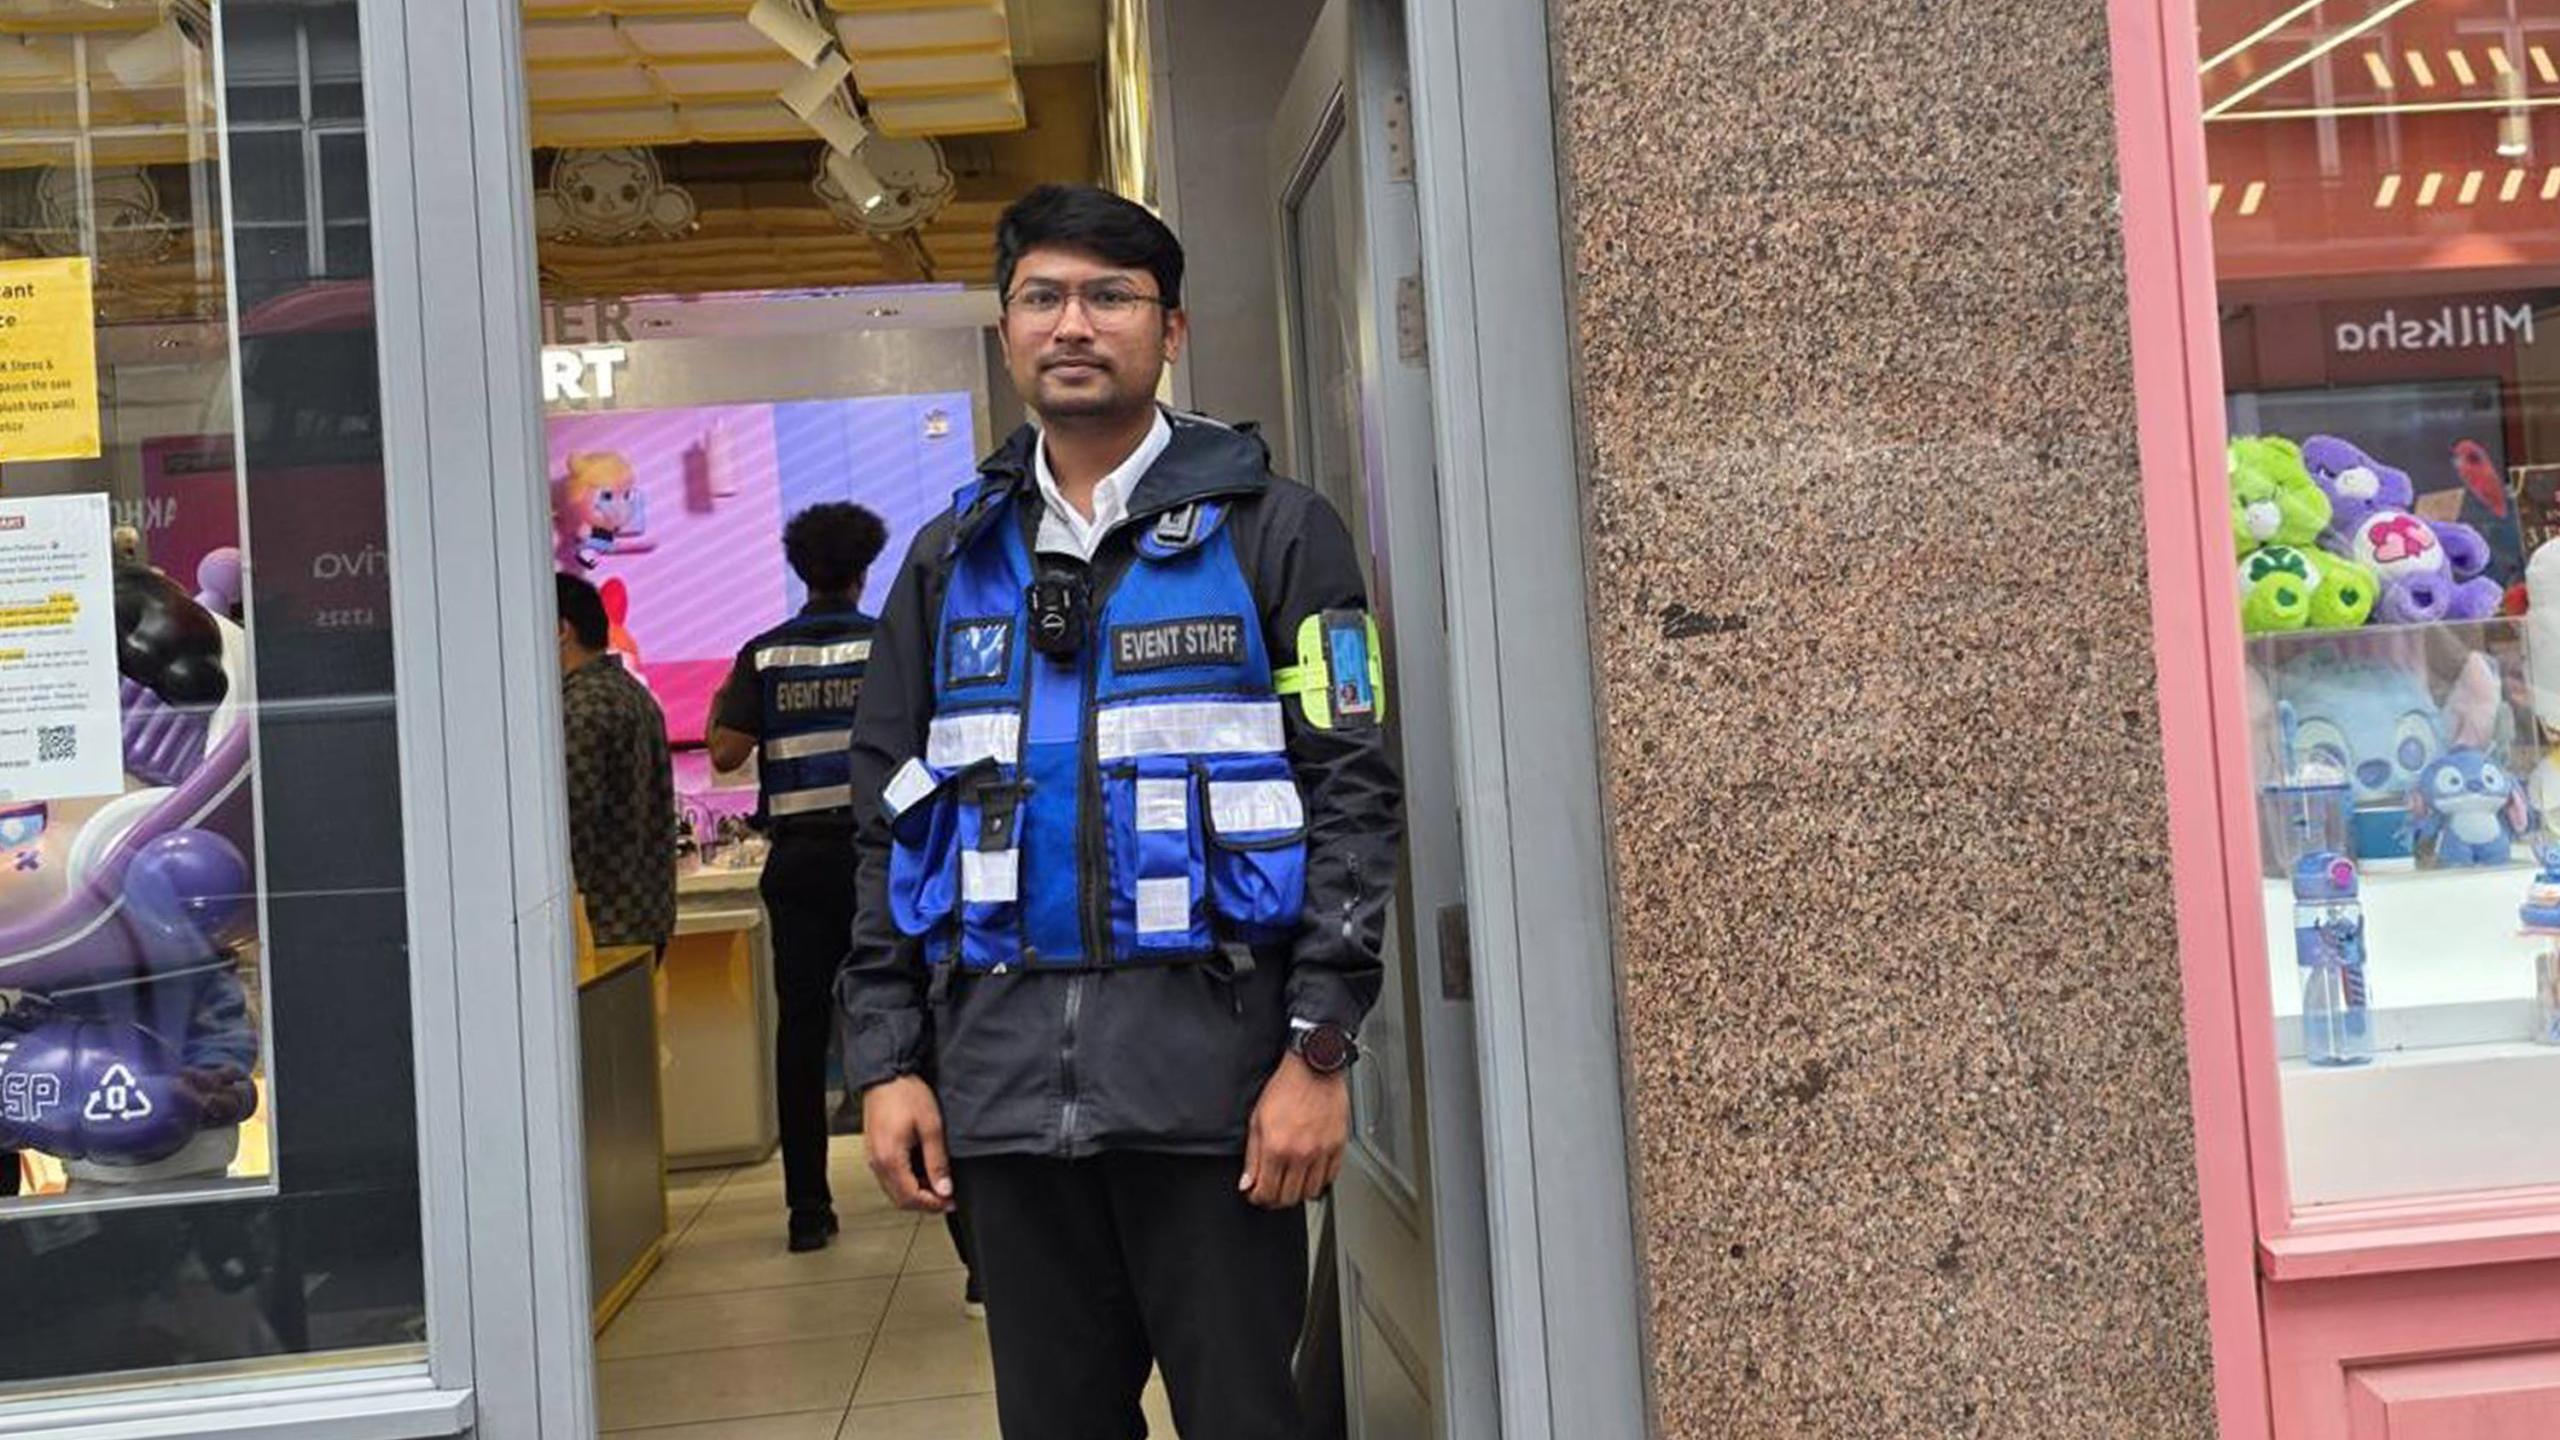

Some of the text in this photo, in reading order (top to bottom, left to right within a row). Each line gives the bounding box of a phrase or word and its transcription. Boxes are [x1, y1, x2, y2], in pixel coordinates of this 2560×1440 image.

[0, 283, 34, 299] ant
[542, 302, 632, 346] ER
[541, 346, 626, 402] RT
[1120, 624, 1237, 661] EVENT STAFF
[777, 680, 820, 711] EVENT
